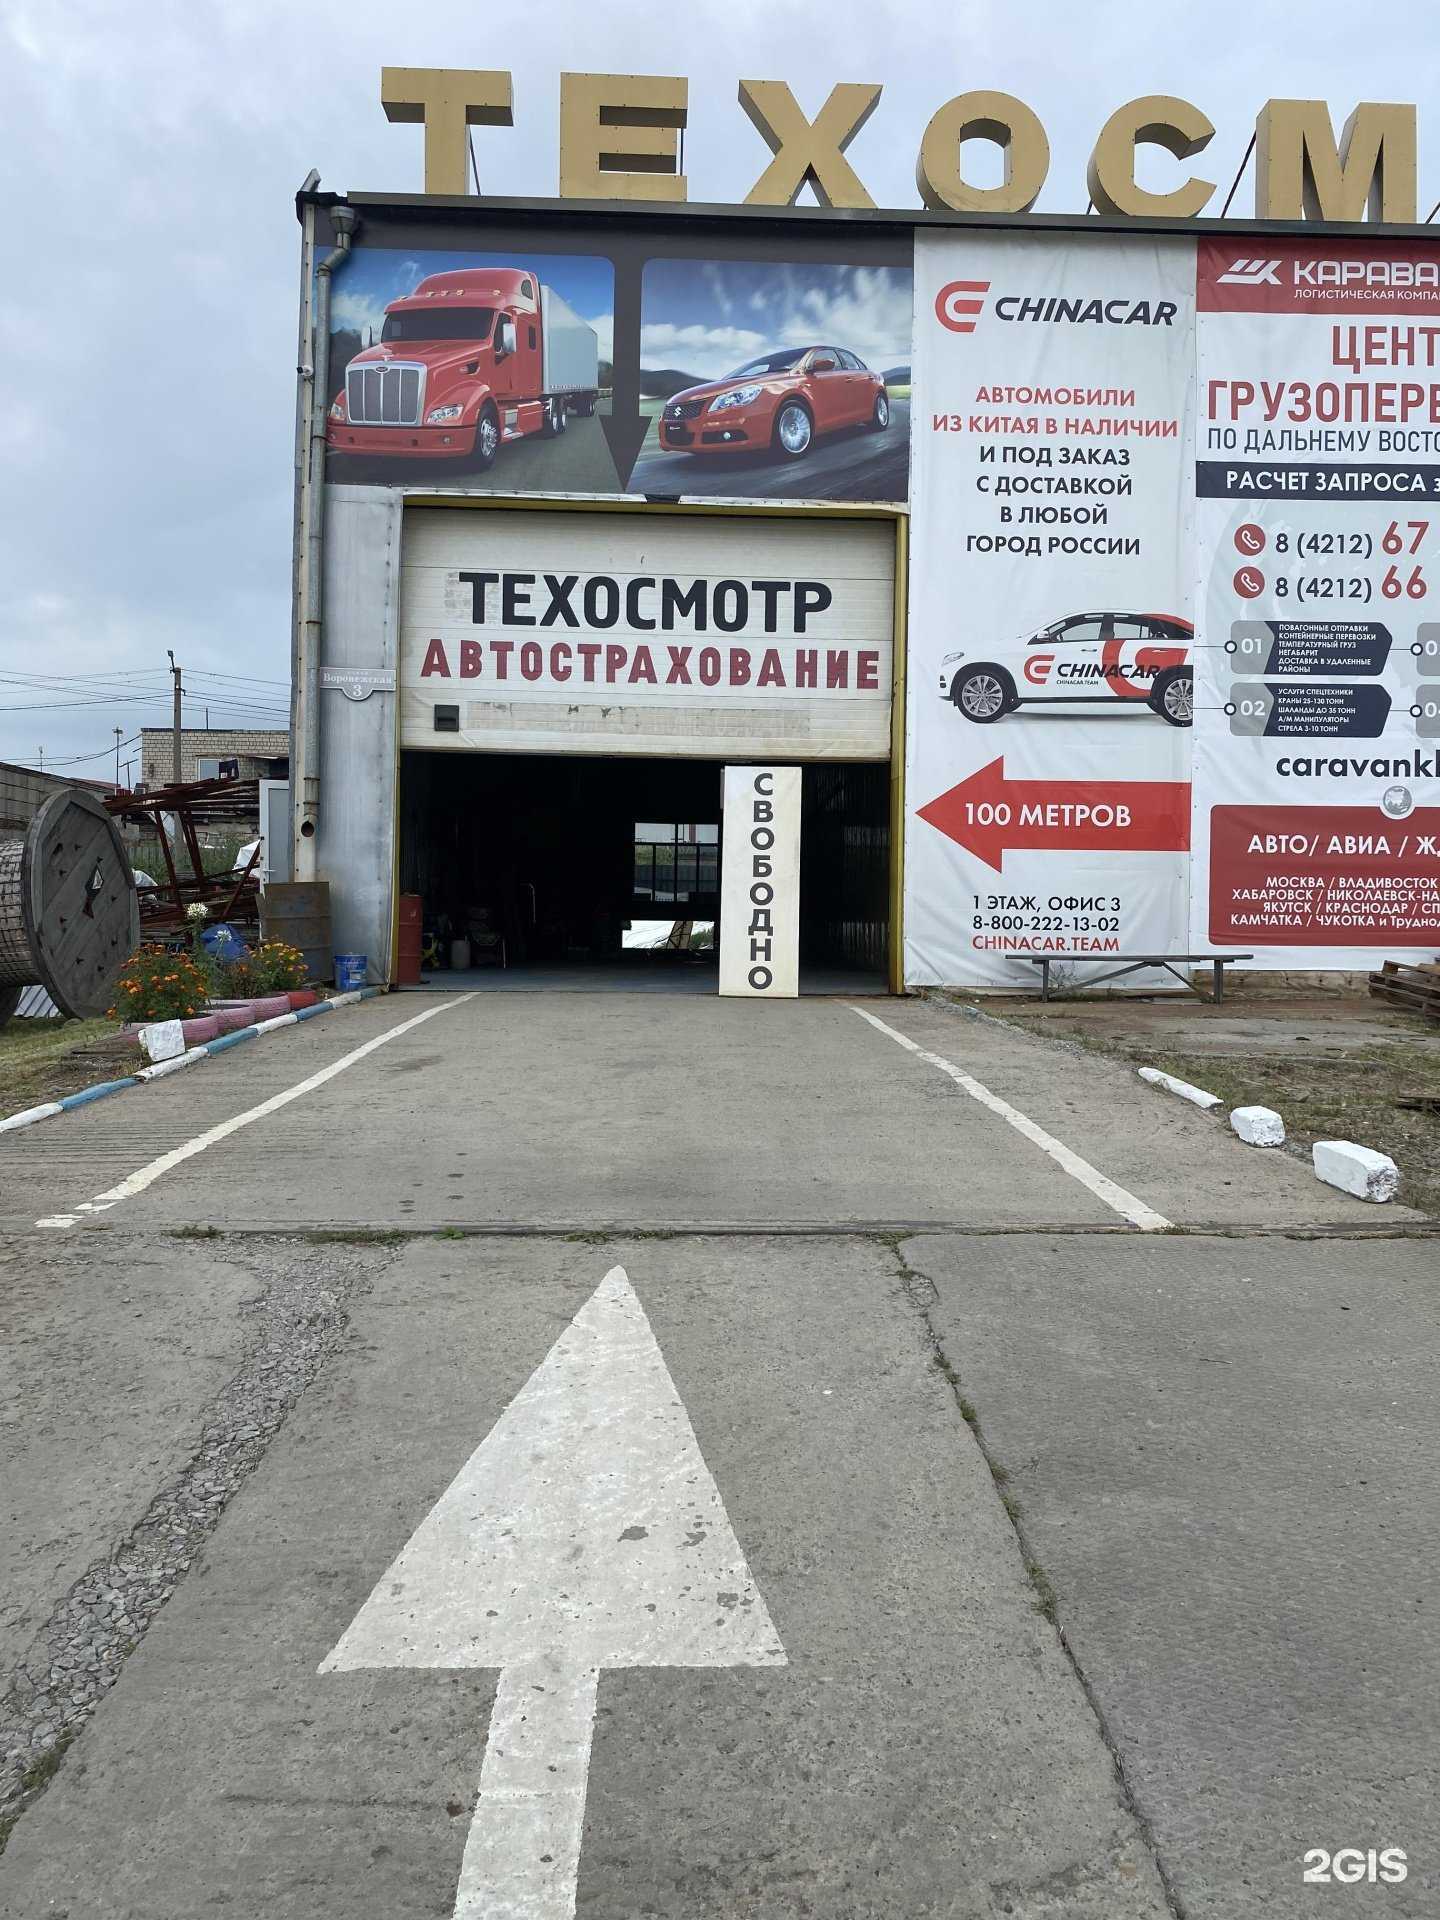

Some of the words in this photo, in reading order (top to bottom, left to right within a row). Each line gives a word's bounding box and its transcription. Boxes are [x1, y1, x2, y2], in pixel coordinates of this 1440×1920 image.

[381, 66, 1416, 223] ТЕХОСМ
[1294, 260, 1439, 287] КАРАВА
[1294, 289, 1394, 300] ЛОГИСТИЧЕСКАЯ
[1398, 290, 1440, 301] КОМПА
[995, 297, 1178, 326] CHINACAR
[1332, 325, 1440, 374] ЦЕНТ
[975, 386, 1135, 407] АВТОМОБИЛИ
[933, 415, 962, 434] ИЗ
[969, 415, 1039, 435] КИТАЯ
[1045, 418, 1058, 435] В
[1065, 418, 1178, 437] НАЛИЧИИ
[1208, 427, 1237, 449] ПО
[1244, 429, 1371, 454] ДАЛЬНЕМУ
[980, 446, 995, 463] И
[1002, 446, 1052, 467] ПОД
[1058, 448, 1130, 466] ЗАКАЗ
[976, 475, 989, 493] С
[994, 474, 1132, 496] ДОСТАВКОЙ
[1226, 470, 1309, 490] РАСЧЕТ
[1315, 472, 1427, 492] ЗАПРОСА
[1000, 506, 1012, 523] В
[1018, 503, 1108, 525] ЛЮБОЙ
[967, 535, 1041, 556] ГОРОД
[1048, 537, 1140, 555] РОССИИ
[1275, 532, 1289, 553] 8
[1297, 533, 1373, 559] (4212)
[1382, 520, 1430, 555] 67
[1275, 577, 1289, 597] 8
[1297, 577, 1372, 603] (4212)
[1381, 565, 1428, 600] 66
[458, 572, 832, 634] ТЕХОСМОТР
[1279, 624, 1329, 632] ПОВАГОННЫЕ
[1279, 632, 1335, 640] КОНТЕЙНЕРНЫЕ
[1335, 633, 1376, 641] ПЕРЕВОЗКИ
[1241, 638, 1262, 654] 01
[1279, 640, 1338, 648] ТЕМПЕРАТУРНЫЙ
[1425, 640, 1440, 656] 0
[420, 638, 880, 690] АВТОСТРАХОВАНИЕ
[1057, 663, 1160, 679] CHINACAR
[1278, 657, 1318, 665] ДОСТАВКА
[1326, 658, 1371, 666] УДАЛЕННЫЕ
[1279, 665, 1311, 673] РАЙОНЫ
[353, 684, 362, 697] 3
[1240, 700, 1266, 716] 02
[1424, 702, 1440, 718] 0
[964, 802, 1011, 826] 100
[1018, 804, 1132, 827] МЕТРОВ
[1326, 835, 1391, 855] АВИА
[1416, 836, 1440, 857] Ж
[747, 772, 774, 991] СВОБОДНО
[1266, 876, 1325, 888] МОСКВА
[1339, 877, 1438, 889] ВЛАДИВОСТОК
[973, 895, 979, 909] 1
[987, 895, 1041, 912] ЭТАЖ,
[1048, 896, 1106, 911] ОФИС
[1110, 897, 1121, 911] 3
[1232, 888, 1313, 900] ХАБАРОВСК
[1327, 889, 1440, 901] НИКОЛАЕВСК-НА
[1263, 902, 1312, 913] ЯКУТСК
[1325, 902, 1408, 914] КРАСНОДАР
[973, 915, 1120, 931] 8-800-222-13-02
[1231, 914, 1302, 926] КАМЧАТКА
[1316, 915, 1375, 926] ЧУКОТКА
[1379, 918, 1387, 926] и
[1390, 915, 1440, 929] Трудно
[972, 935, 1120, 951] CHINACAR.TEAM
